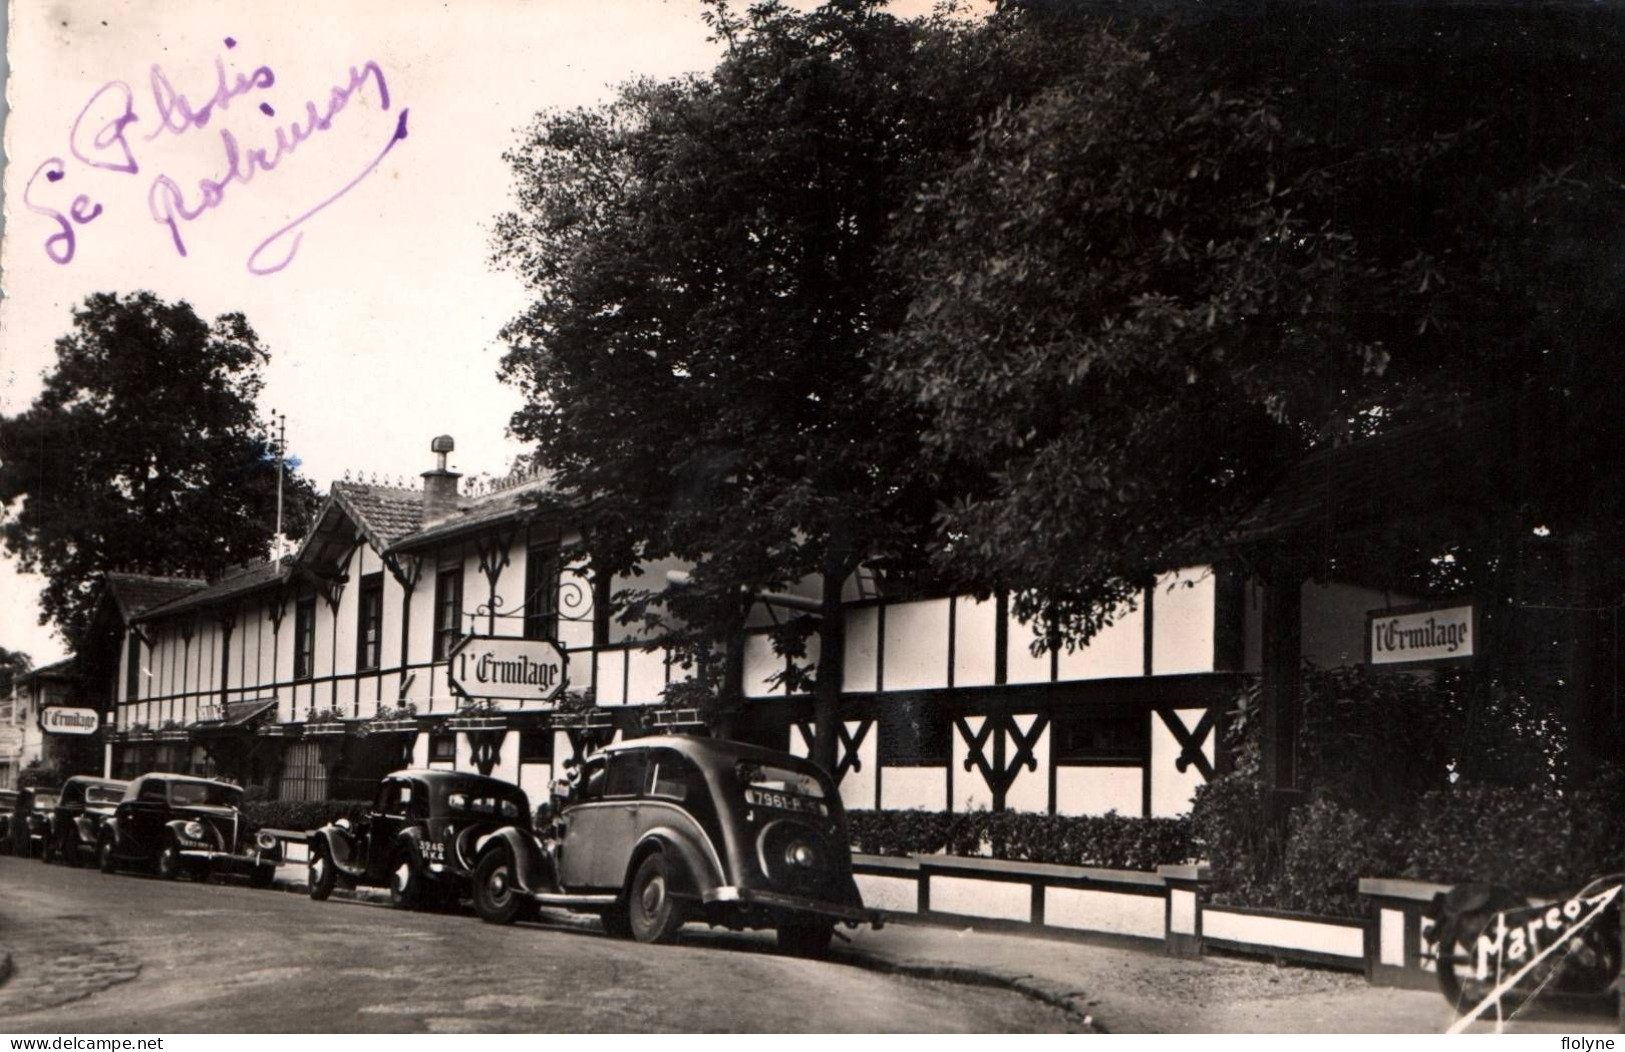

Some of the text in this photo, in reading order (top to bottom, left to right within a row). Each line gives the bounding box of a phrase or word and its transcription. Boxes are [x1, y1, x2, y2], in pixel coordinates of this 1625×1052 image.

[148, 60, 391, 257] Robinson
[1376, 617, 1468, 652] l'Ermitage
[459, 650, 559, 692] l'Ermitage
[44, 710, 96, 730] l'Ermitage
